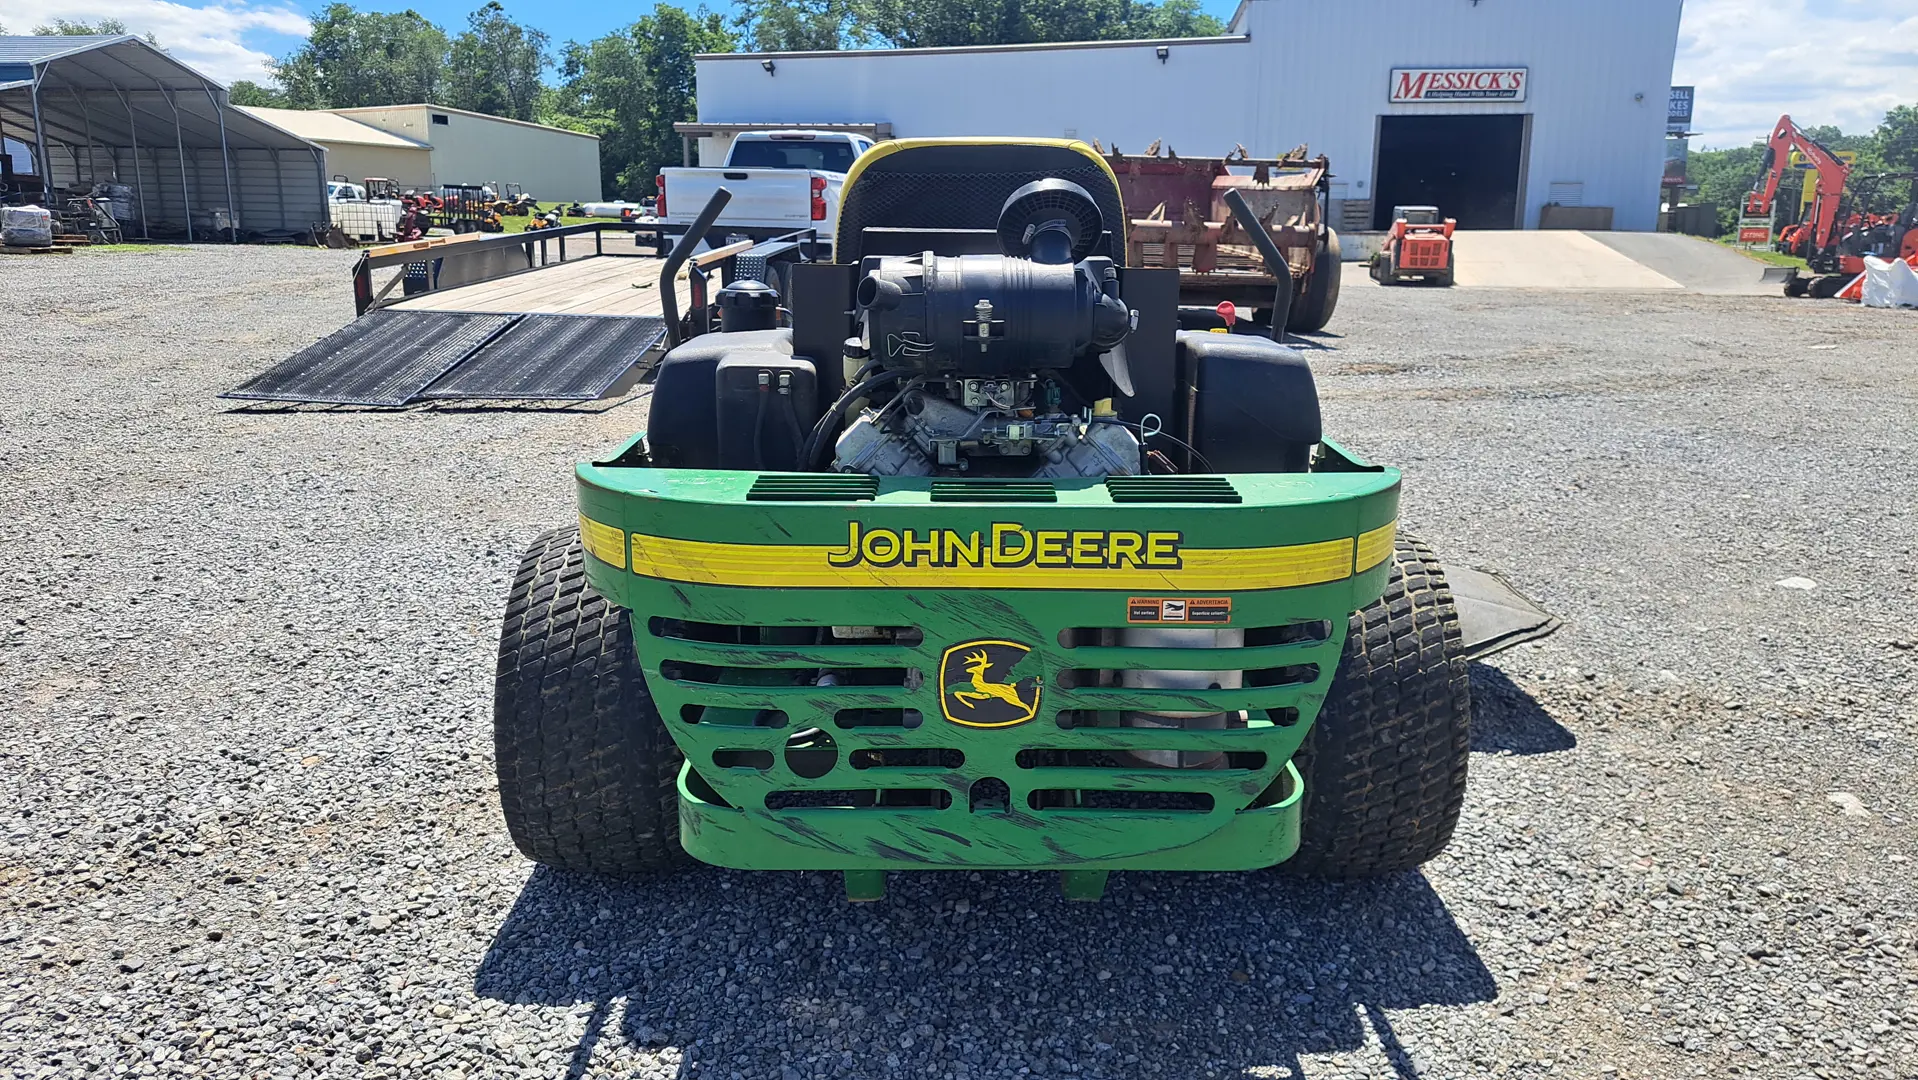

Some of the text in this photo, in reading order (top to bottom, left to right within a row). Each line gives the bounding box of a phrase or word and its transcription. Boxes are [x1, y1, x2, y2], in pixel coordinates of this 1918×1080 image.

[1394, 72, 1523, 99] MESSICK'S
[1670, 91, 1689, 100] SELL
[828, 520, 1183, 570] JOHN DEERE
